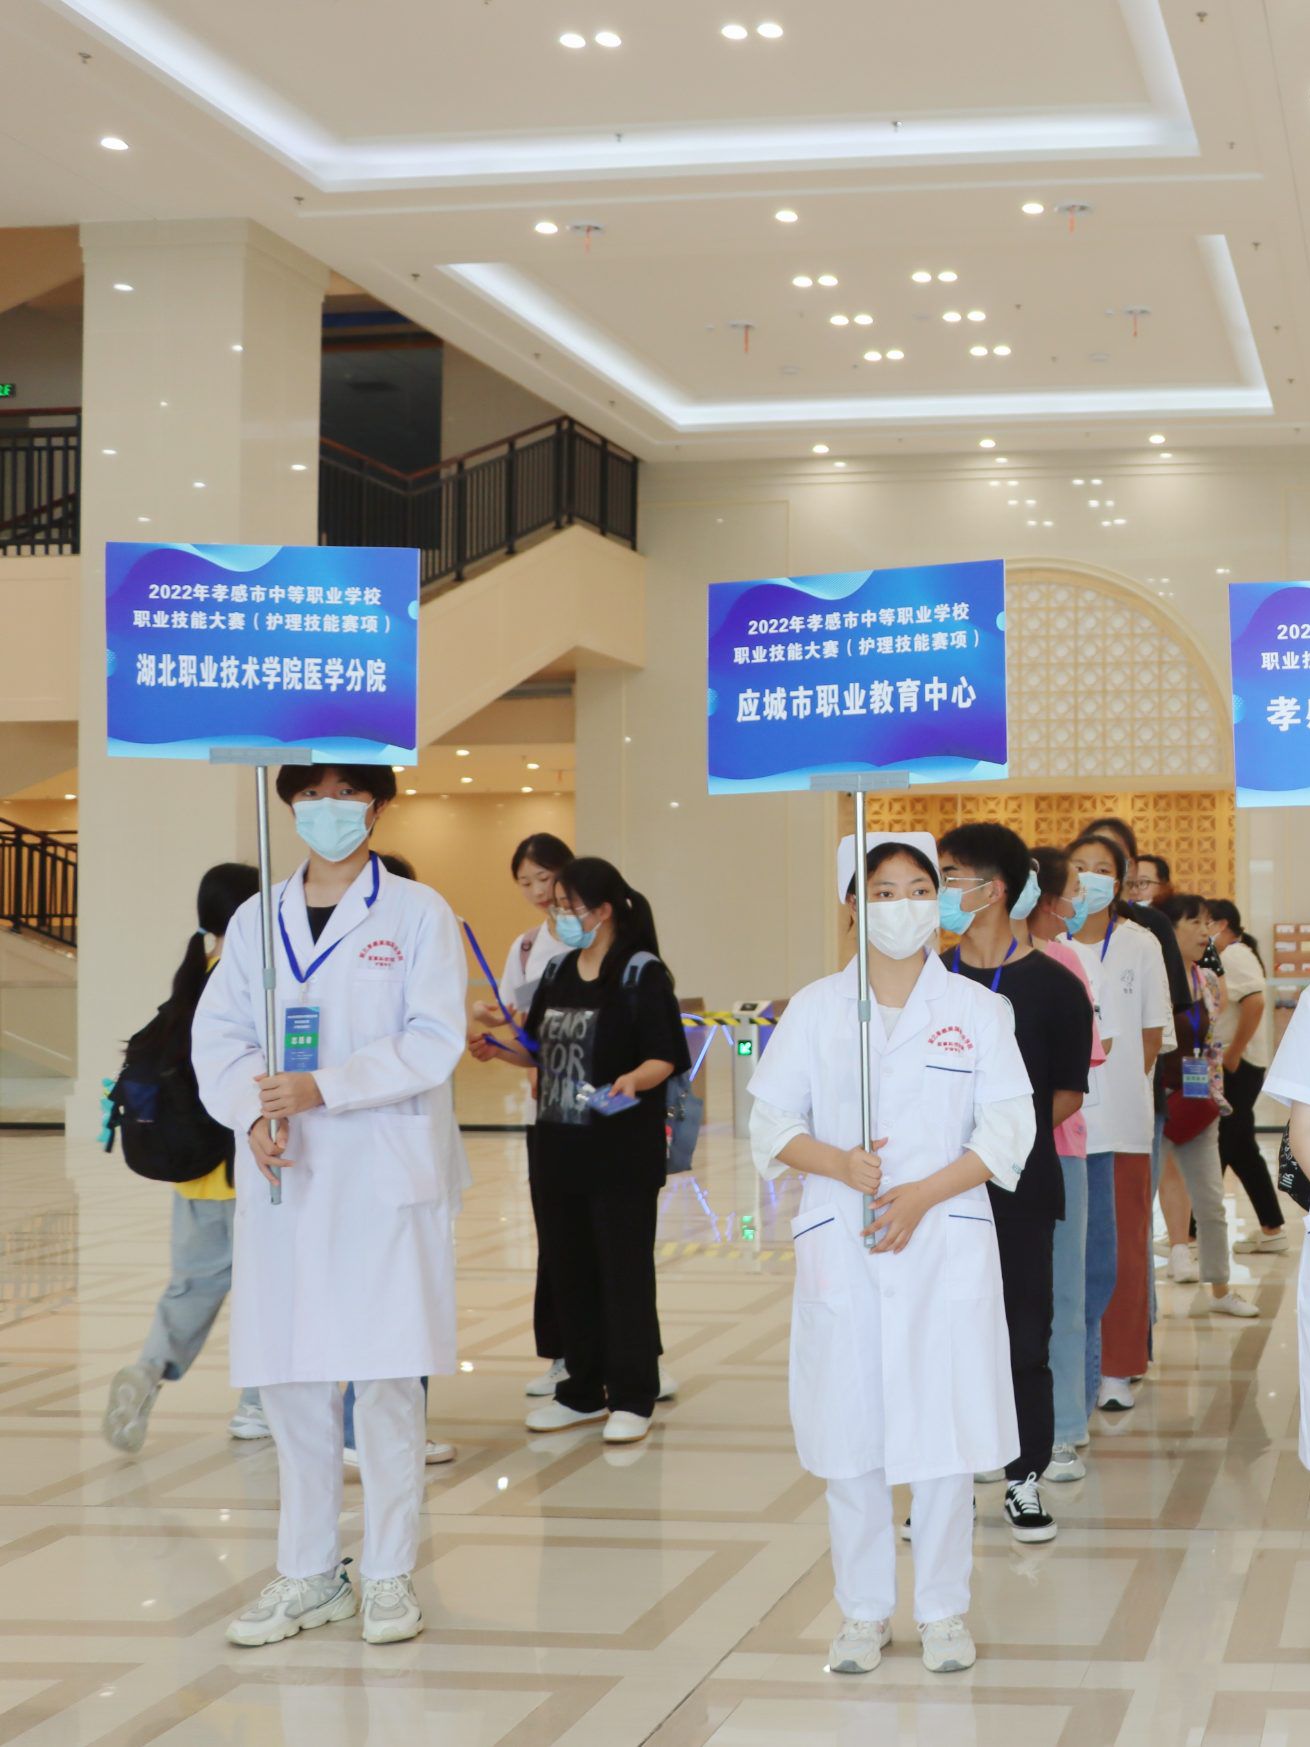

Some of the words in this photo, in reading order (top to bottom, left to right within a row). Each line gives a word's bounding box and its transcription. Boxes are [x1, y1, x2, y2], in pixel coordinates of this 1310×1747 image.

[149, 584, 381, 605] 2022年孝感市中等职业学校
[748, 602, 969, 635] 2022年孝感市中等职业学校
[136, 653, 387, 692] 湖北职业技术学院医学分院
[737, 676, 977, 722] 应城市职业教育中心
